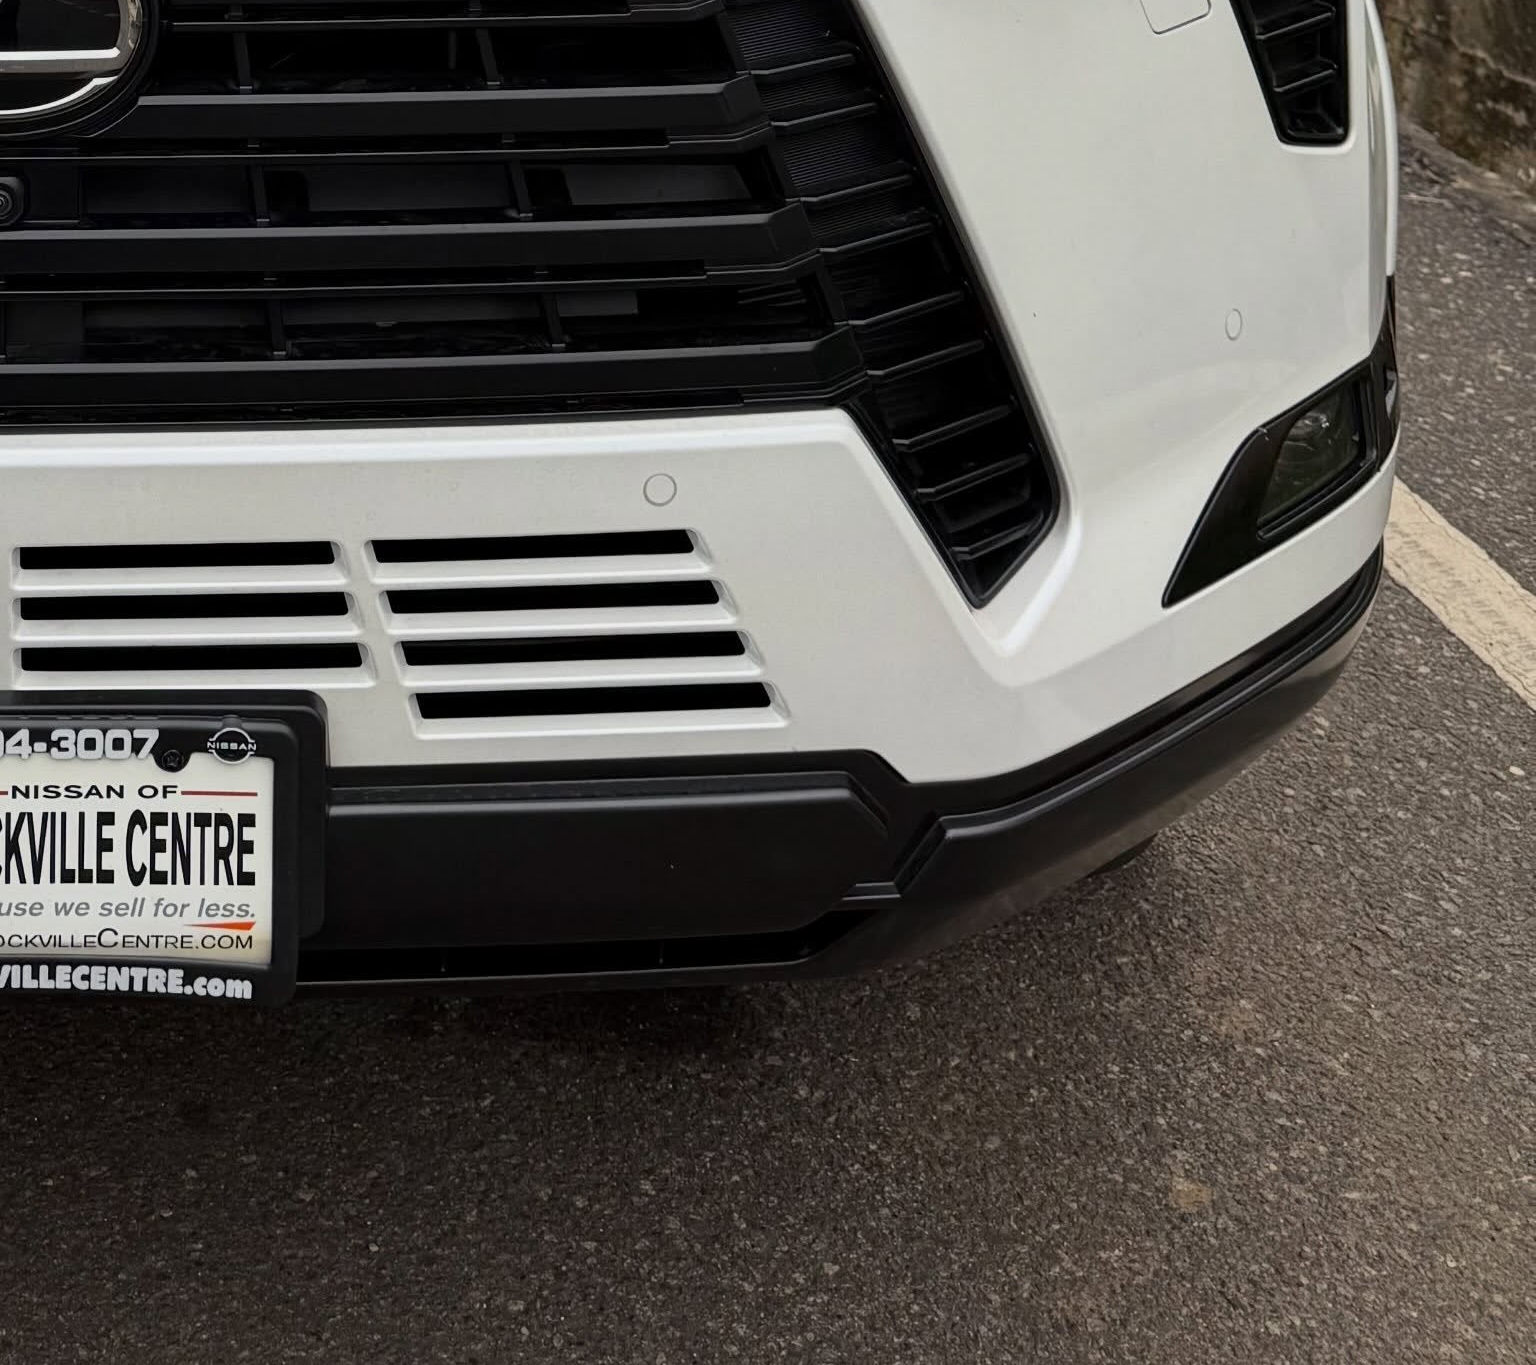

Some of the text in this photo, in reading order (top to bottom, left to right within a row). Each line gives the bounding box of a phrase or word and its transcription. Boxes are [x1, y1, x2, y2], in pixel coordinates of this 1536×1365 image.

[207, 740, 257, 751] NISSAN
[11, 785, 179, 800] NISSAN OF
[125, 809, 257, 888] CENTRE
[54, 902, 90, 917] we
[98, 897, 145, 918] sell
[153, 897, 189, 918] for
[197, 898, 256, 919] less.
